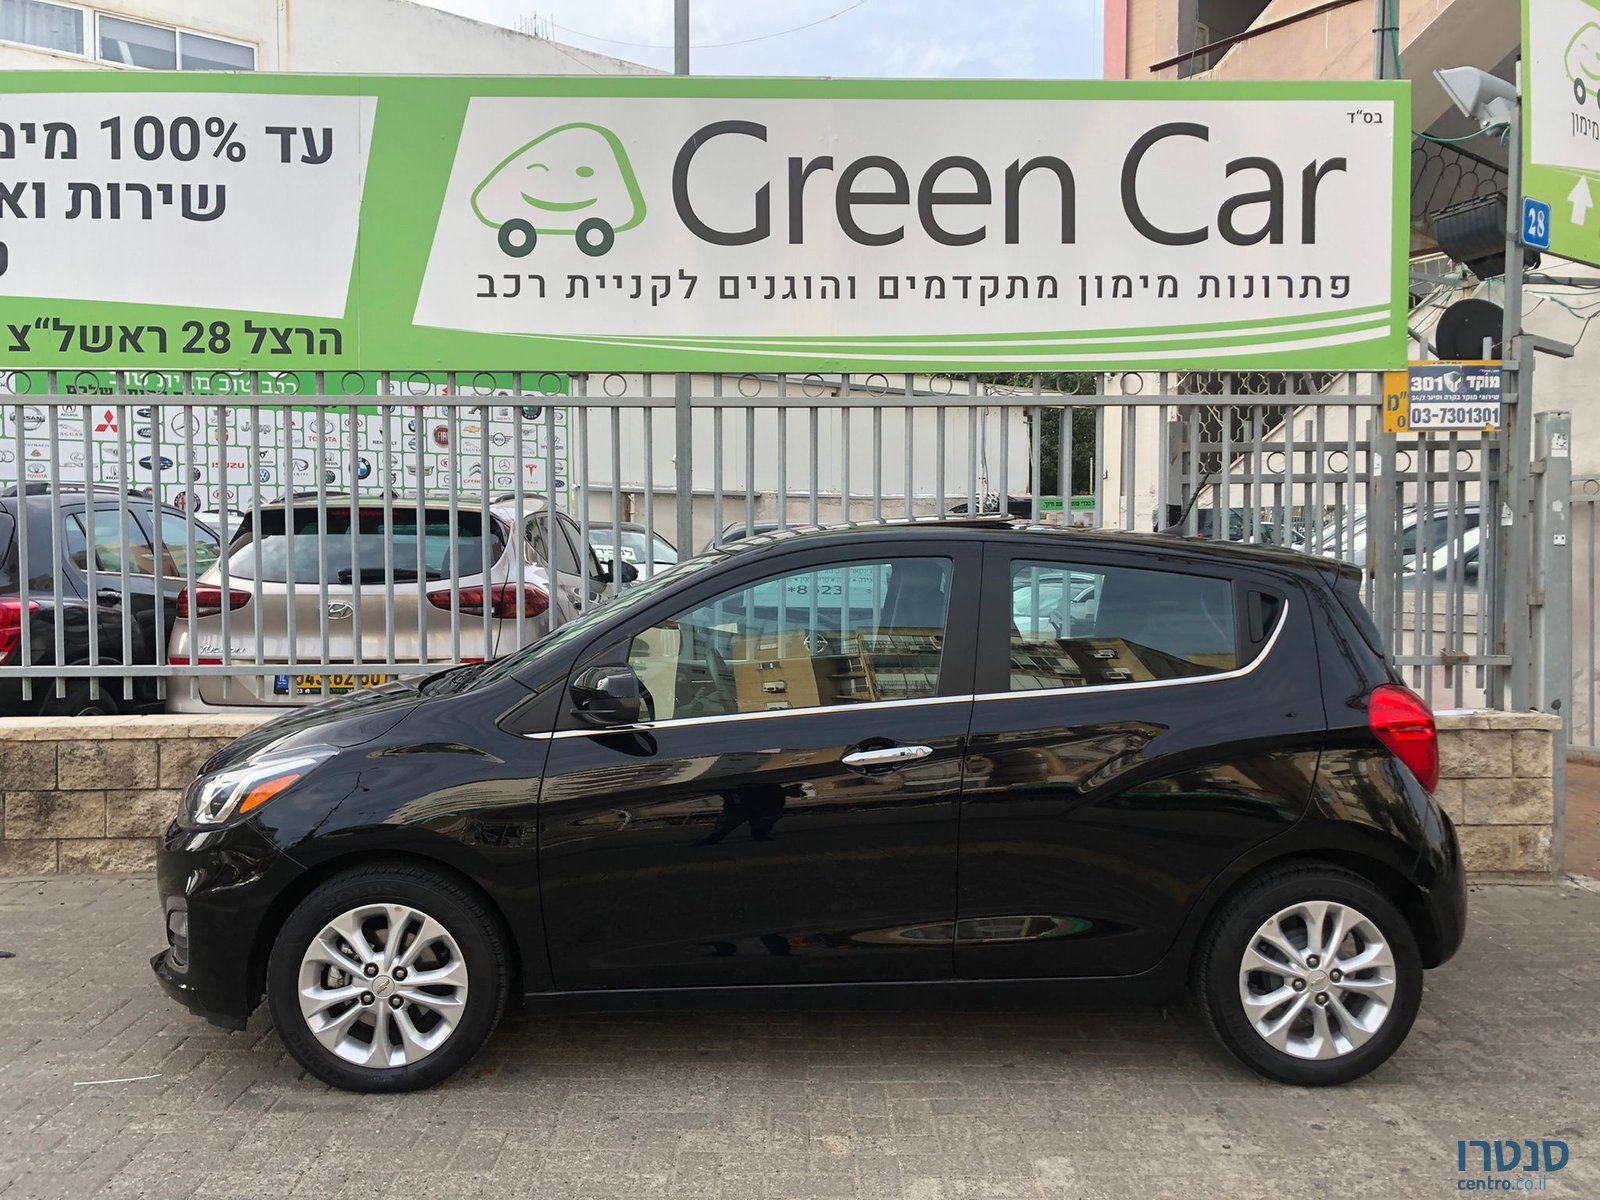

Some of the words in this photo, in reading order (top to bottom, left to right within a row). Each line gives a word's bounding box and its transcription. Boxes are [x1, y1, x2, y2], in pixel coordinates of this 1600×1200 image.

[1347, 110, 1383, 124] בס"ד
[1571, 112, 1600, 141] מימון
[101, 116, 246, 162] 100%
[266, 126, 333, 165] עד
[672, 121, 1076, 247] Green
[1121, 122, 1350, 246] Car
[66, 182, 226, 222] שירות
[1527, 207, 1545, 239] 28
[476, 274, 545, 299] רכב
[566, 268, 699, 307] לקניית
[720, 275, 856, 300] והוגנים
[879, 275, 1058, 307] מתקדמים
[1079, 275, 1178, 306] מימון
[1198, 275, 1350, 299] פתרונות
[8, 317, 167, 353] ראשל"צ
[182, 320, 231, 354] 28
[245, 320, 342, 355] הרצל
[1410, 376, 1443, 391] 301
[1411, 408, 1499, 424] 03-7301301
